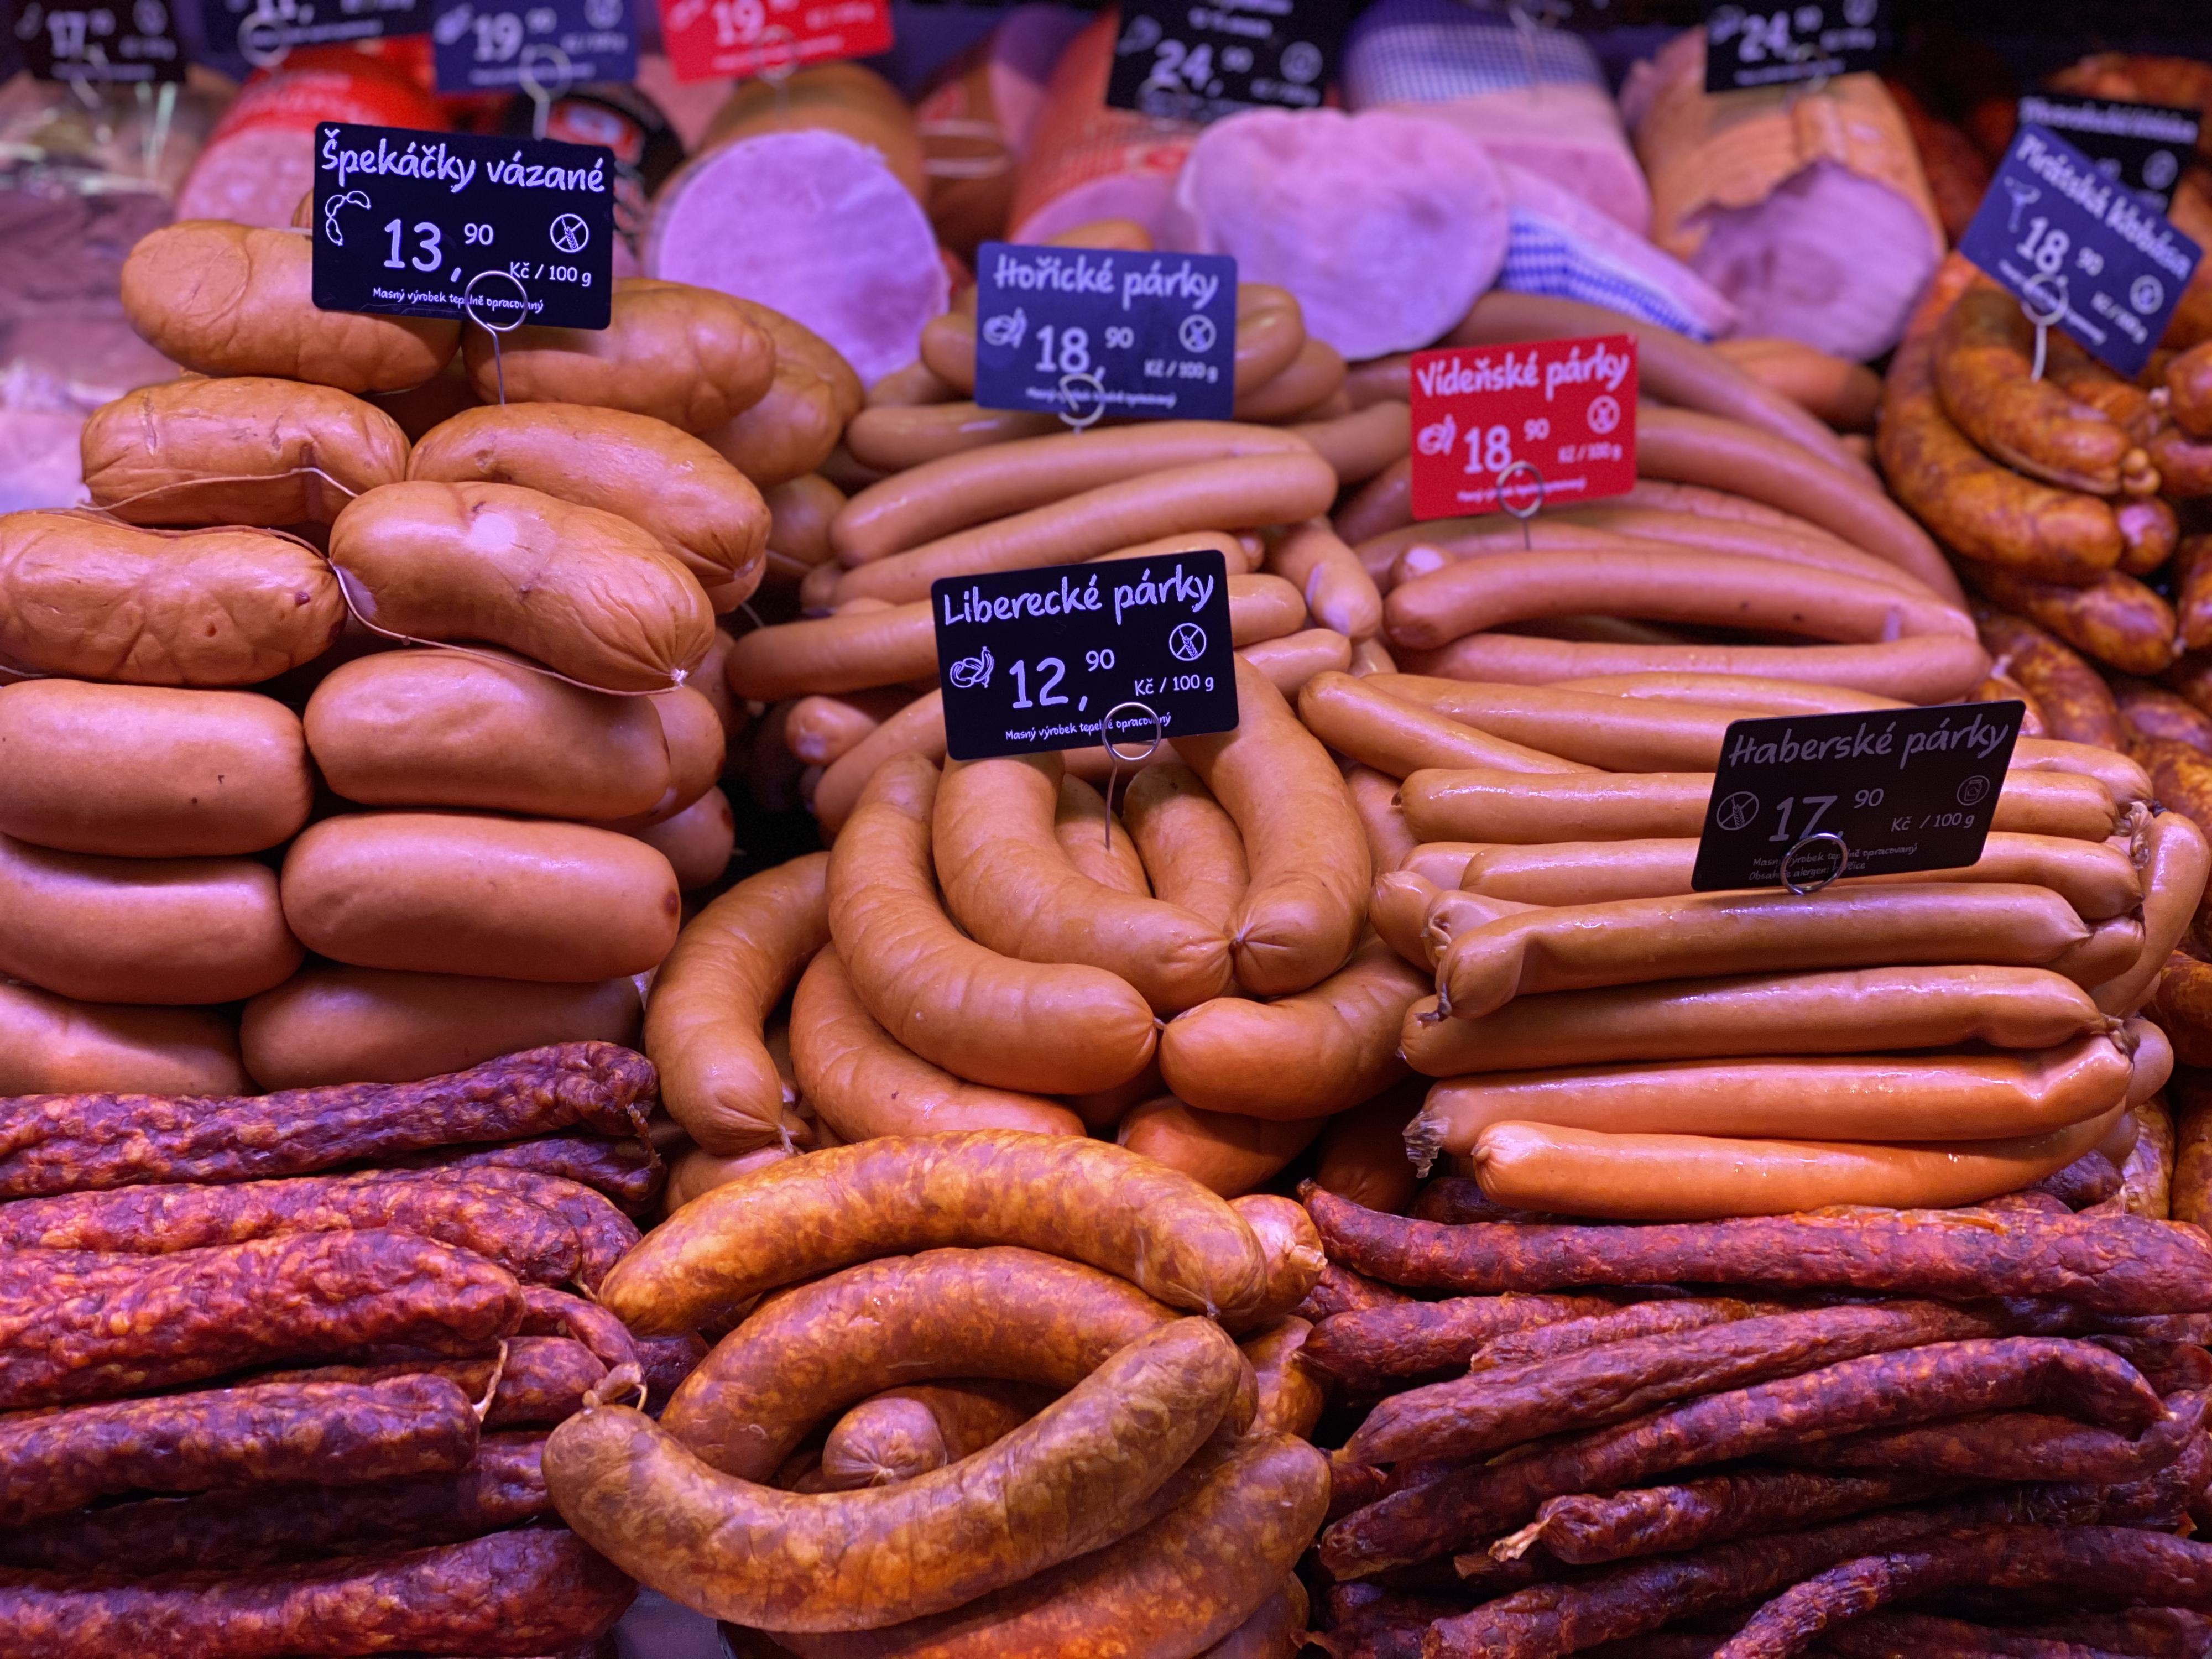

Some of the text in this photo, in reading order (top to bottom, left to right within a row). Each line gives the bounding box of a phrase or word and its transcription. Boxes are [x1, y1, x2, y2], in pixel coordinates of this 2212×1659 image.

[322, 128, 605, 193] Špekáčky vázané
[463, 223, 494, 246] 90
[510, 262, 529, 278] Kč
[549, 265, 577, 281] 100
[581, 272, 592, 287] g
[993, 253, 1219, 311] Hořické párky
[373, 287, 405, 303] Masný
[408, 290, 447, 304] výrobek
[449, 294, 484, 309] teplně
[1105, 326, 1135, 349] 90
[1416, 342, 1630, 402] Vídeňské párky
[944, 564, 1214, 625] Liberecké párky
[1009, 649, 1115, 712] 12, 90
[1135, 678, 1154, 697] Kč
[1172, 674, 1201, 691] 100
[1204, 676, 1214, 692] g
[1005, 727, 1037, 742] Masný
[1039, 722, 1077, 740] výrobek
[1079, 718, 1114, 737] tepelě
[1728, 713, 2010, 770] Haberské párky
[1853, 787, 1885, 810] 90
[1890, 816, 1911, 833] Kč
[1932, 813, 1963, 828] 100
[1963, 813, 1975, 829] g
[1862, 843, 1918, 860] opracovaný
